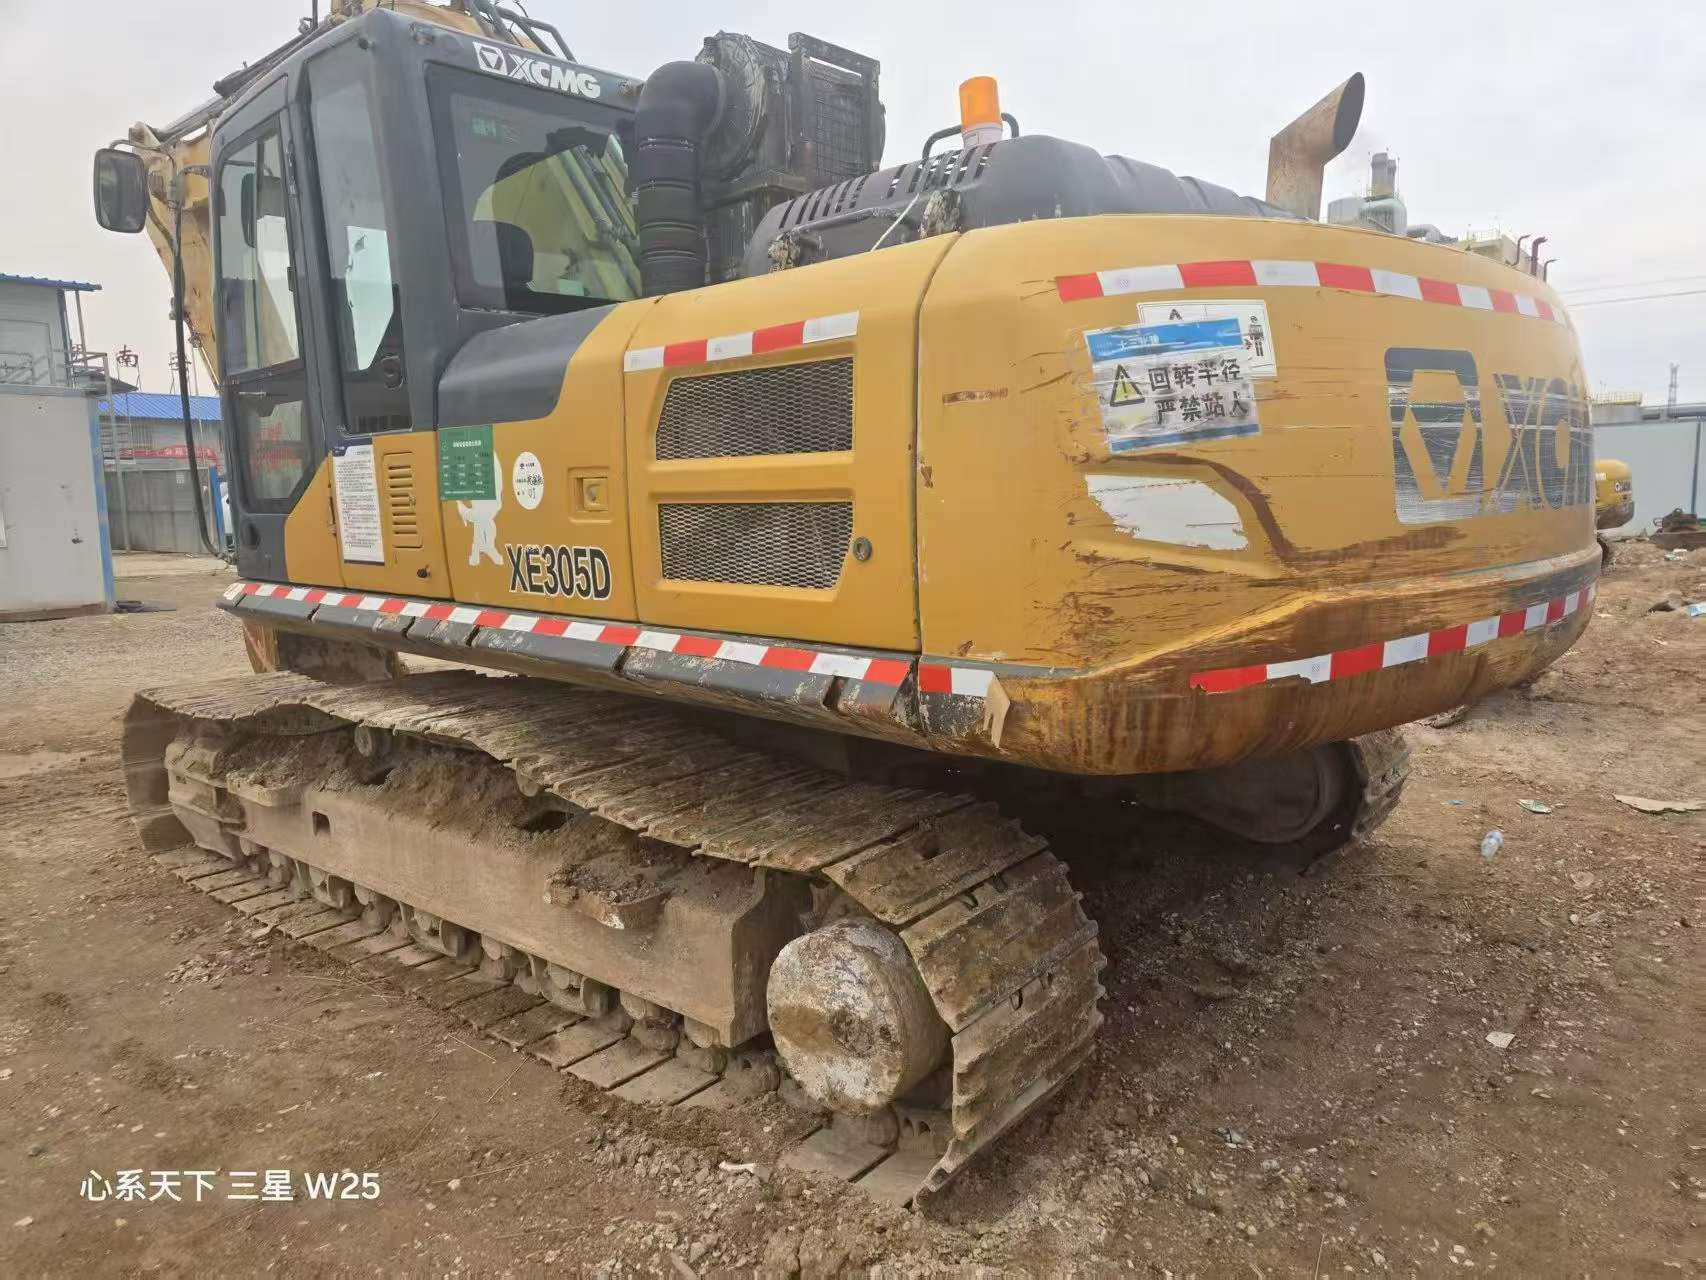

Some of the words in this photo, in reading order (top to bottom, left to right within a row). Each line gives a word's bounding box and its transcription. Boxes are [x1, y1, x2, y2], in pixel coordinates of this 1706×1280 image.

[508, 52, 601, 99] XCMG
[1147, 358, 1243, 391] 回转半径
[1153, 390, 1249, 426] 严禁站人
[505, 543, 612, 600] XE305D
